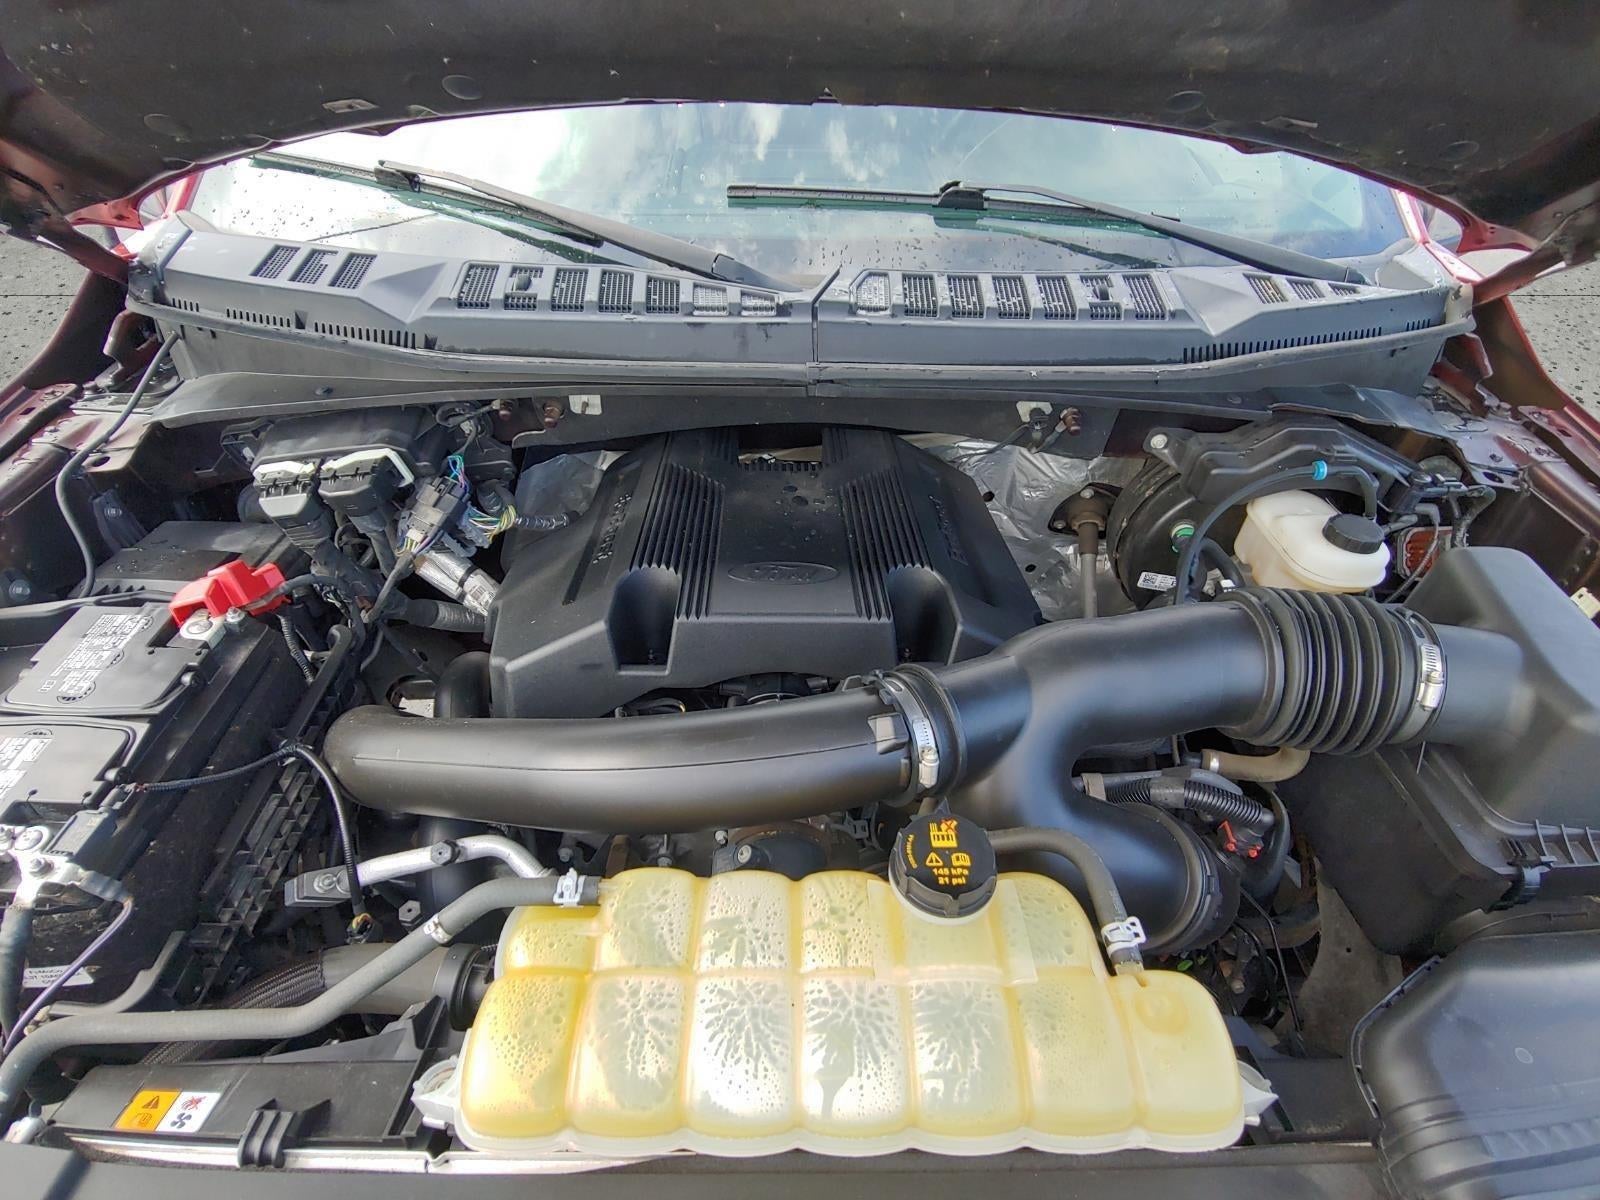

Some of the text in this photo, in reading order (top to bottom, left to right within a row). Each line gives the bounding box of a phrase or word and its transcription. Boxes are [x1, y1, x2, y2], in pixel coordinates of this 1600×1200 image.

[951, 867, 969, 876] kPa
[938, 876, 966, 886] 21 psi
